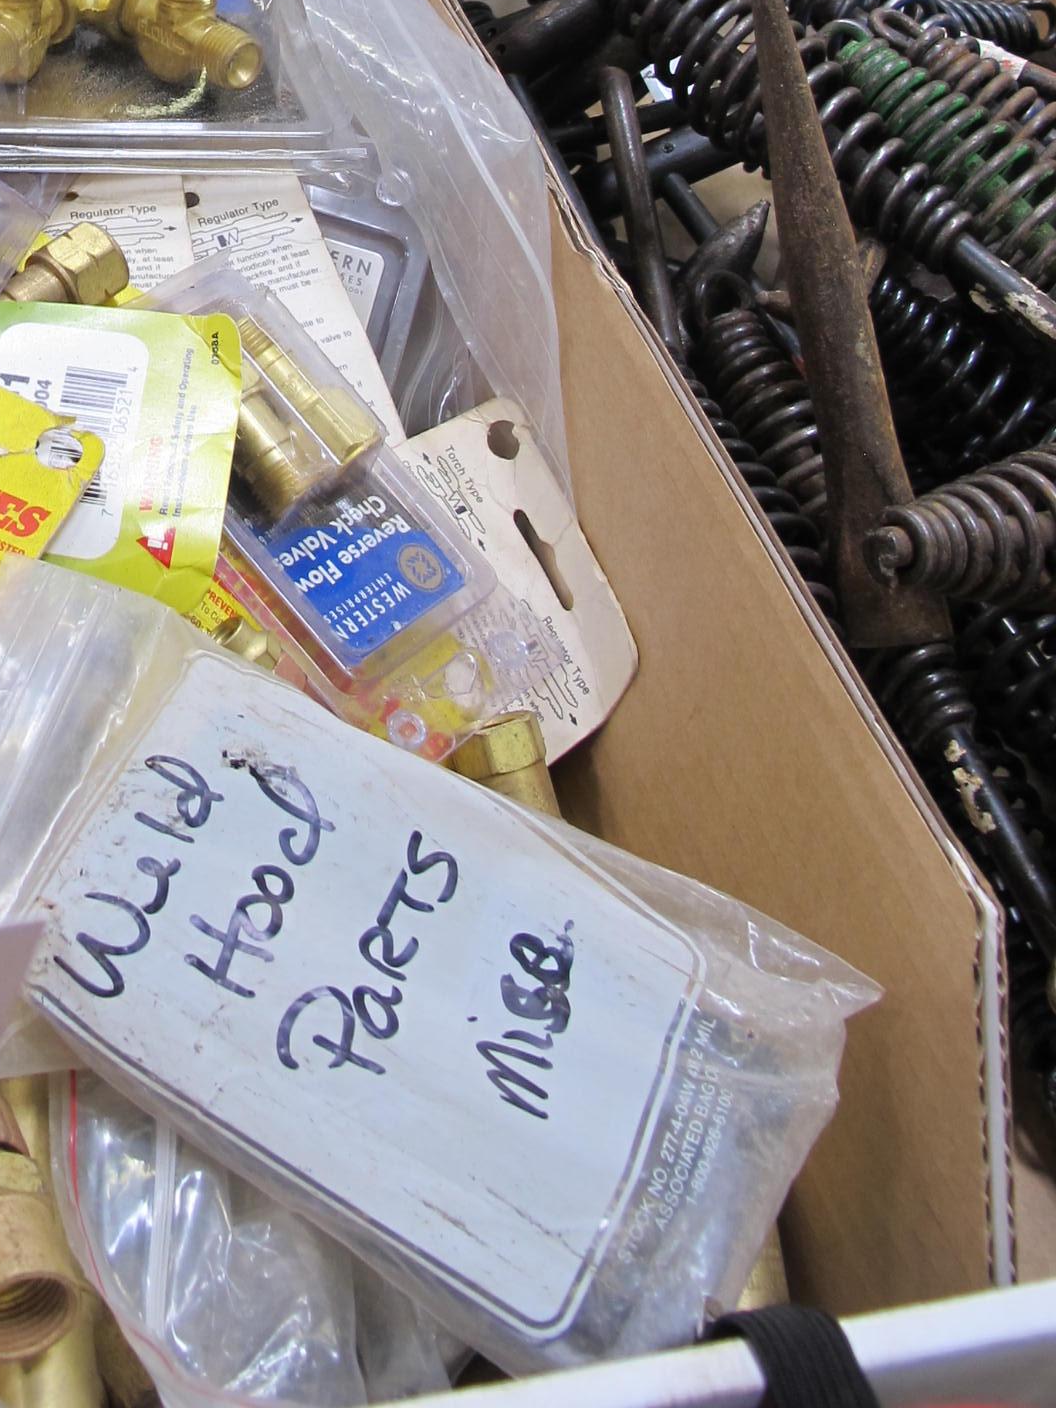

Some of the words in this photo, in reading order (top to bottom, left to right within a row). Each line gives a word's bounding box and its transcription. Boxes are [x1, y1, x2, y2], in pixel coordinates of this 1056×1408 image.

[70, 207, 124, 220] Regulator
[128, 204, 156, 215] Type
[197, 208, 249, 227] Regulator
[253, 198, 279, 213] Type
[445, 446, 466, 478] Torch
[465, 478, 483, 503] Type
[329, 495, 387, 536] Check
[338, 514, 411, 564] Reverse
[295, 560, 342, 593] Flow
[323, 573, 393, 624] ENTERPRISES
[331, 582, 411, 640] WESTERN
[572, 667, 590, 695] Type
[53, 754, 225, 998] Weld
[184, 758, 337, 998] Hood
[617, 1197, 655, 1265] STOCK
[647, 1167, 670, 1197] NO.
[695, 1018, 717, 1047] MIL
[655, 1118, 704, 1232] ASSOCIATED
[694, 1082, 717, 1117] BAG
